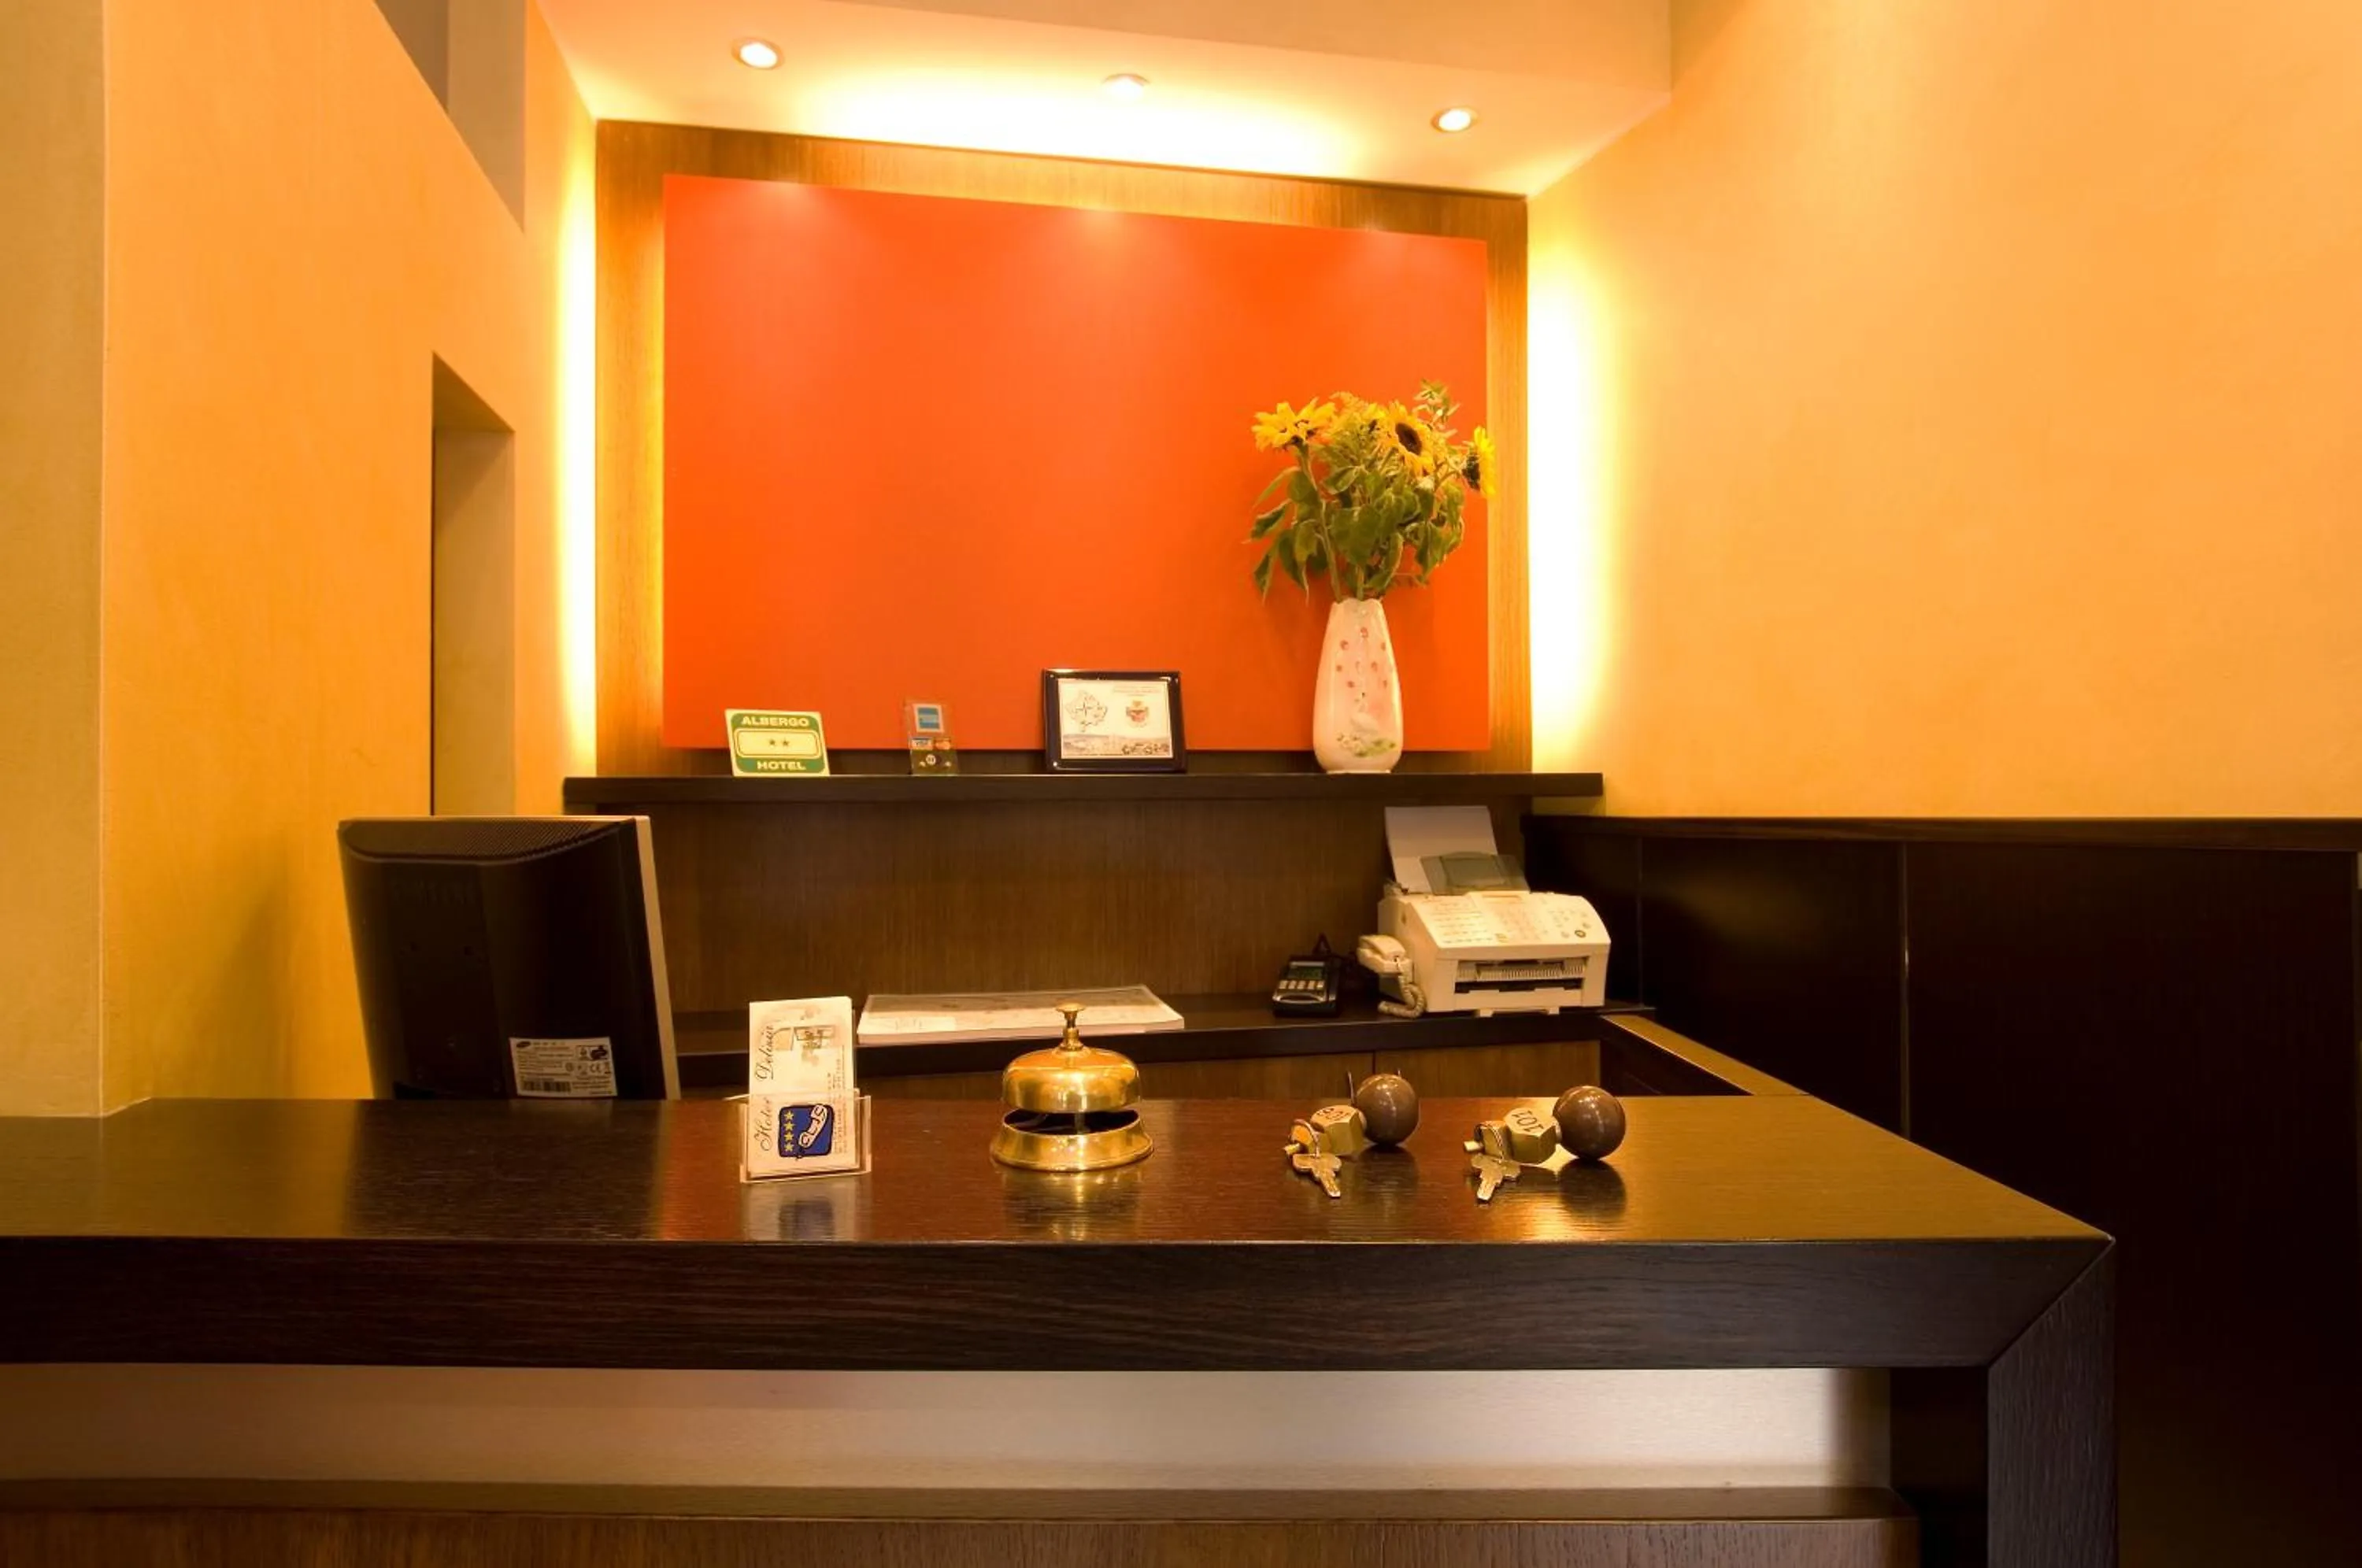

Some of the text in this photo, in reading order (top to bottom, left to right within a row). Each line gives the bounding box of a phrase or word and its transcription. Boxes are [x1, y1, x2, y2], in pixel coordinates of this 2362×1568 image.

[742, 716, 809, 727] ALBERGO
[757, 760, 807, 771] HOTEL
[1511, 1109, 1545, 1133] 101
